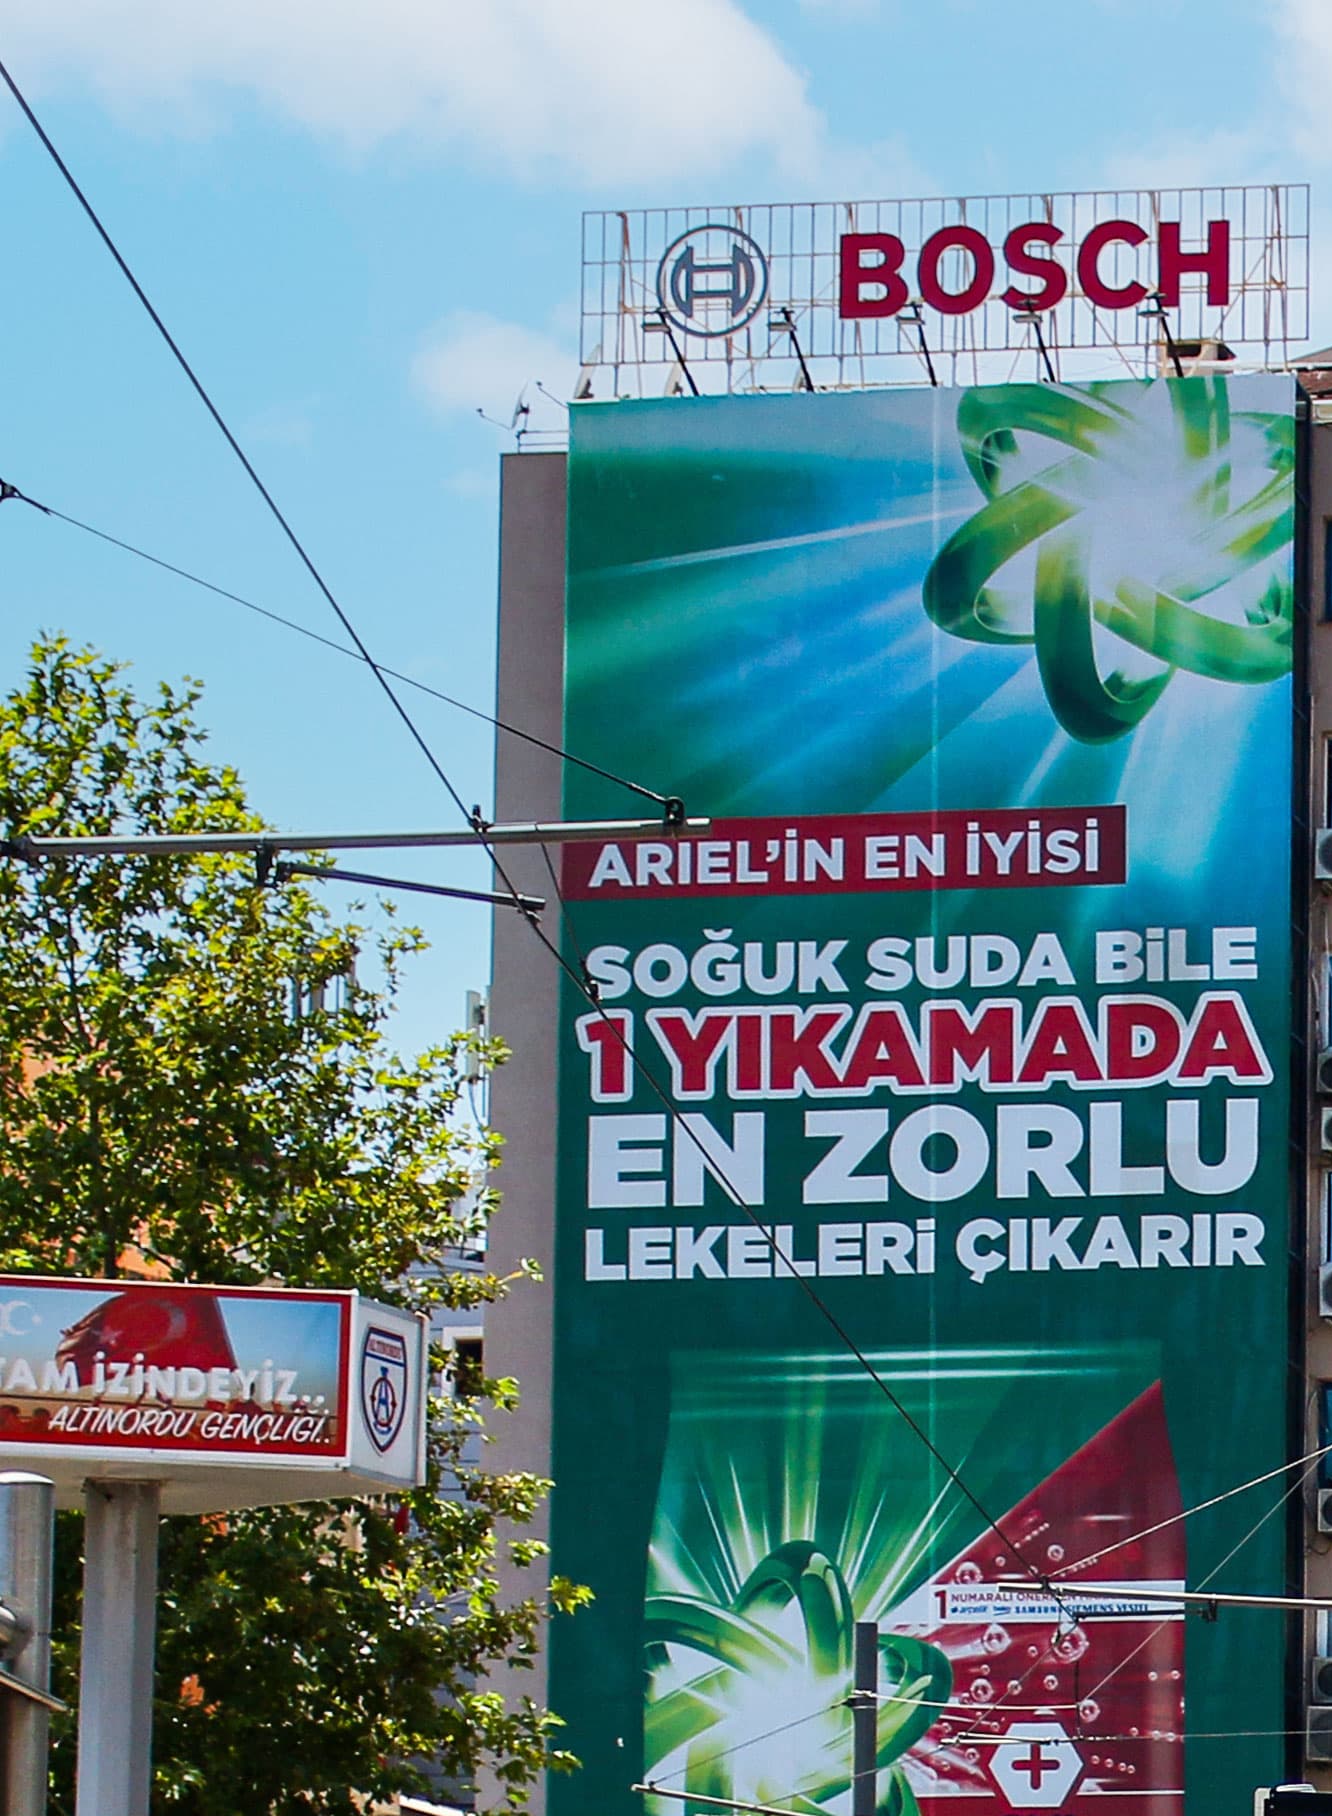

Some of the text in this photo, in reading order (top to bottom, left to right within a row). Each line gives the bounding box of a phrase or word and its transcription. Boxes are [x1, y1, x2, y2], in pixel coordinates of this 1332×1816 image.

[838, 218, 1231, 321] BOSCH
[865, 833, 948, 879] EN
[966, 818, 1100, 875] İYİSİ
[587, 926, 1258, 999] SOĞUK SUDA BİLE
[576, 990, 1274, 1101] 1 YIKAMADA
[588, 1098, 1260, 1209] EN ZORLU
[585, 1212, 1266, 1284] LEKELERİ ÇIKARIR
[48, 1404, 198, 1437] ALTINORDU
[933, 1590, 948, 1619] 1
